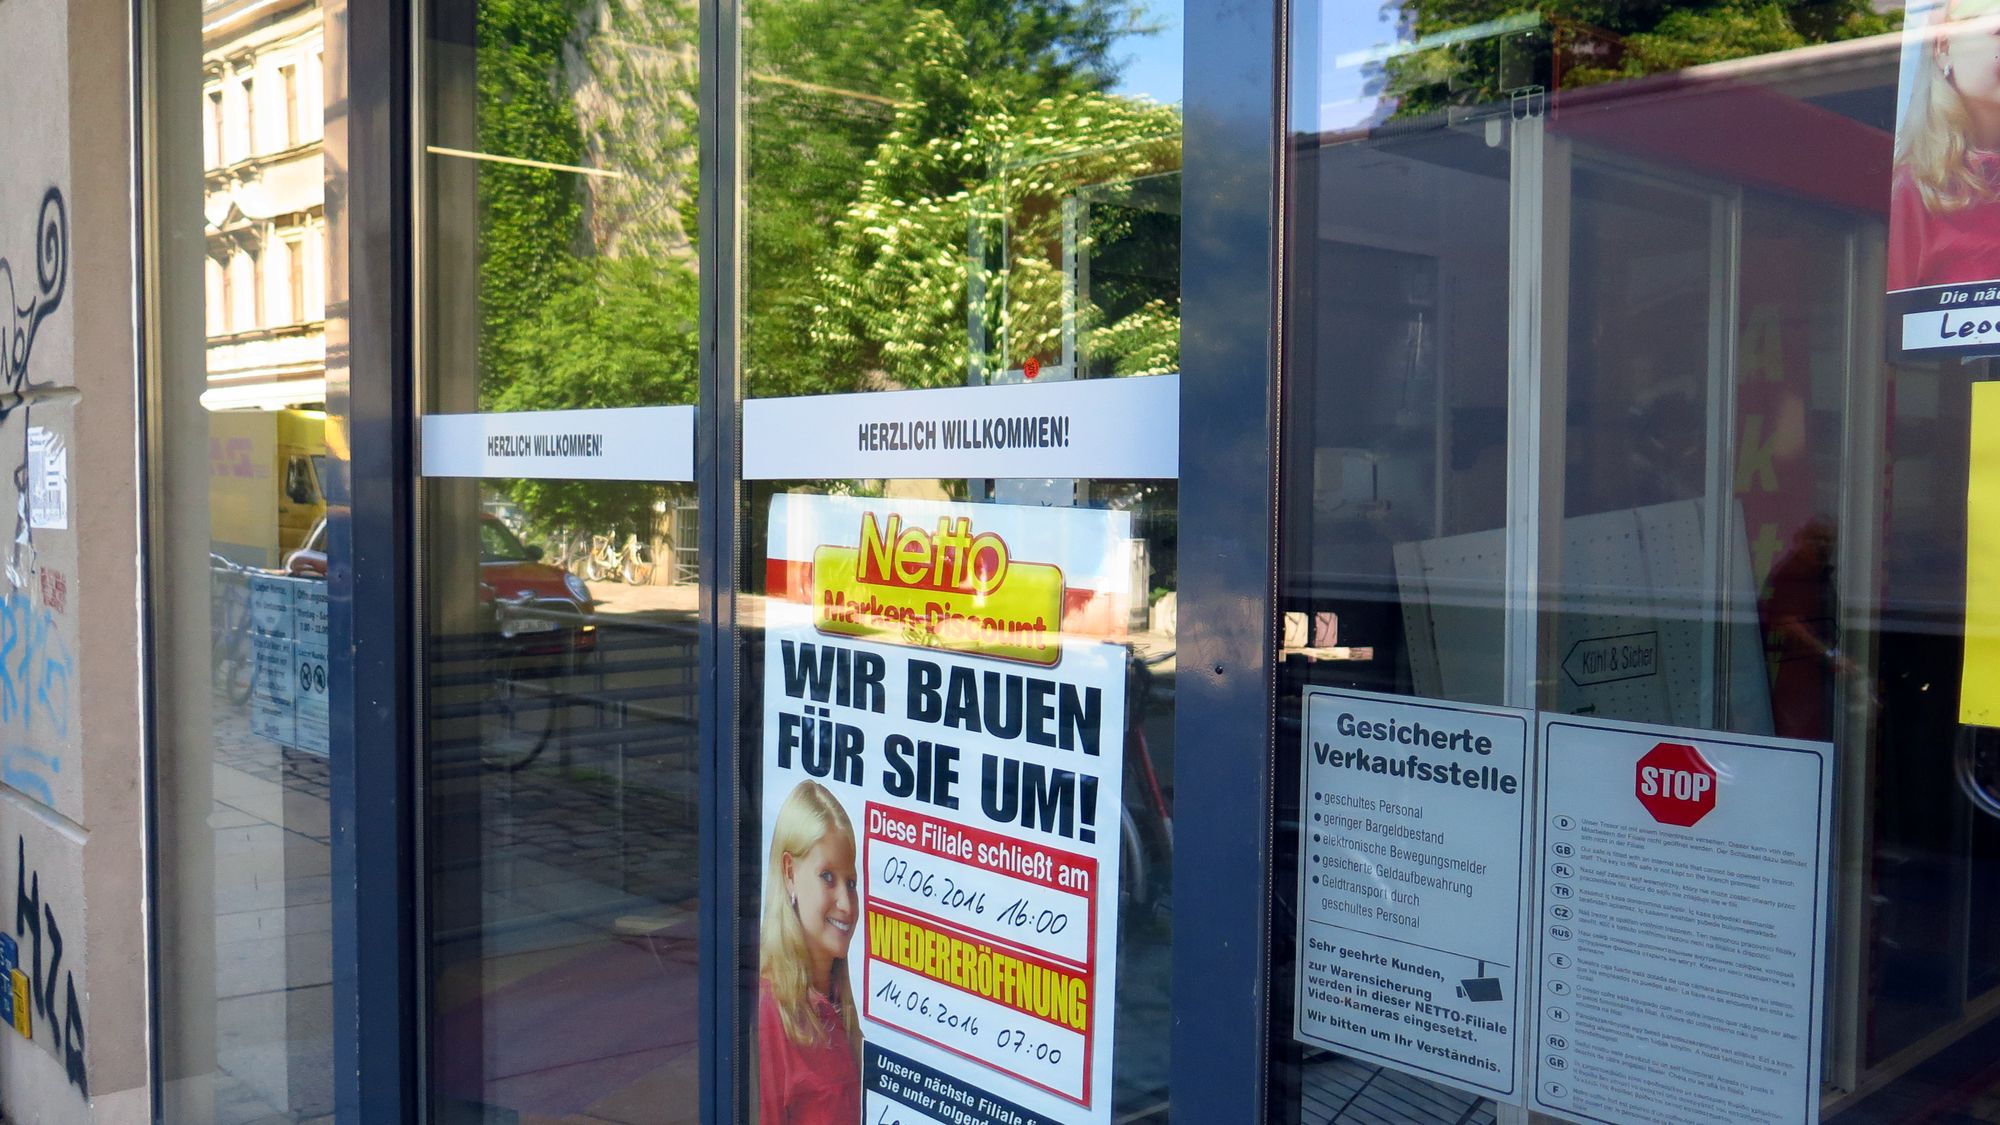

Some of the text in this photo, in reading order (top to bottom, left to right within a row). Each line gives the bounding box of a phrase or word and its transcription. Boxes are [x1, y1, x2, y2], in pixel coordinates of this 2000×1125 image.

[1939, 290, 1969, 304] Die
[487, 433, 603, 457] HERZLICH WILLKOMMEN!
[858, 415, 1070, 451] HERZLICH WILLKOMMEN!
[857, 511, 1010, 595] Netto
[823, 589, 1047, 650] Marken-Discount
[1583, 645, 1653, 675] Kühl & Sicher
[780, 639, 1102, 757] WIR BAUEN
[1337, 713, 1492, 756] Gesicherte
[777, 704, 1099, 845] FÜR SIE UM!
[1313, 741, 1518, 795] Verkaufsstelle
[1641, 766, 1711, 802] STOP
[1324, 792, 1423, 819] geschultes Personal
[1561, 819, 1569, 827] D
[1323, 813, 1444, 845] geringer Bargeldbestand
[869, 808, 1089, 892] Diese Filiale schließt am
[1322, 834, 1487, 875] elektronische Bewegungsmelder
[1556, 845, 1571, 855] GB
[1322, 855, 1473, 898] gesicherte Geldaufbewahrung
[1556, 866, 1570, 876] PL
[883, 856, 1068, 935] 07.06.2016 16:00
[1321, 874, 1420, 907] Geldtransport durch
[1555, 886, 1570, 896] TR
[1321, 897, 1420, 928] geschultes Personal
[1554, 908, 1568, 917] CZ
[1552, 928, 1570, 938] RUS
[868, 910, 1087, 1031] WIEDERERÖFFNUNG
[1308, 937, 1445, 983] Sehr geehrte Kunden,
[1556, 957, 1563, 965] E
[1308, 960, 1432, 1001] zur Warensicherung
[1555, 984, 1563, 992] P
[876, 980, 1062, 1064] 14.06.2016 07:00
[1308, 975, 1507, 1035] werden in dieser NETTO-Filiale
[1308, 987, 1477, 1042] Video-Kameras eingesetzt.
[1554, 1010, 1562, 1019] H
[1307, 1008, 1501, 1073] Wir bitten um Ihr Verständnis.
[1550, 1037, 1565, 1047] RO
[1549, 1058, 1564, 1068] GR
[877, 1054, 1022, 1125] Unsere nächste Filiale
[879, 1074, 899, 1094] Sie
[903, 1086, 937, 1110] unter
[1552, 1086, 1559, 1094] F
